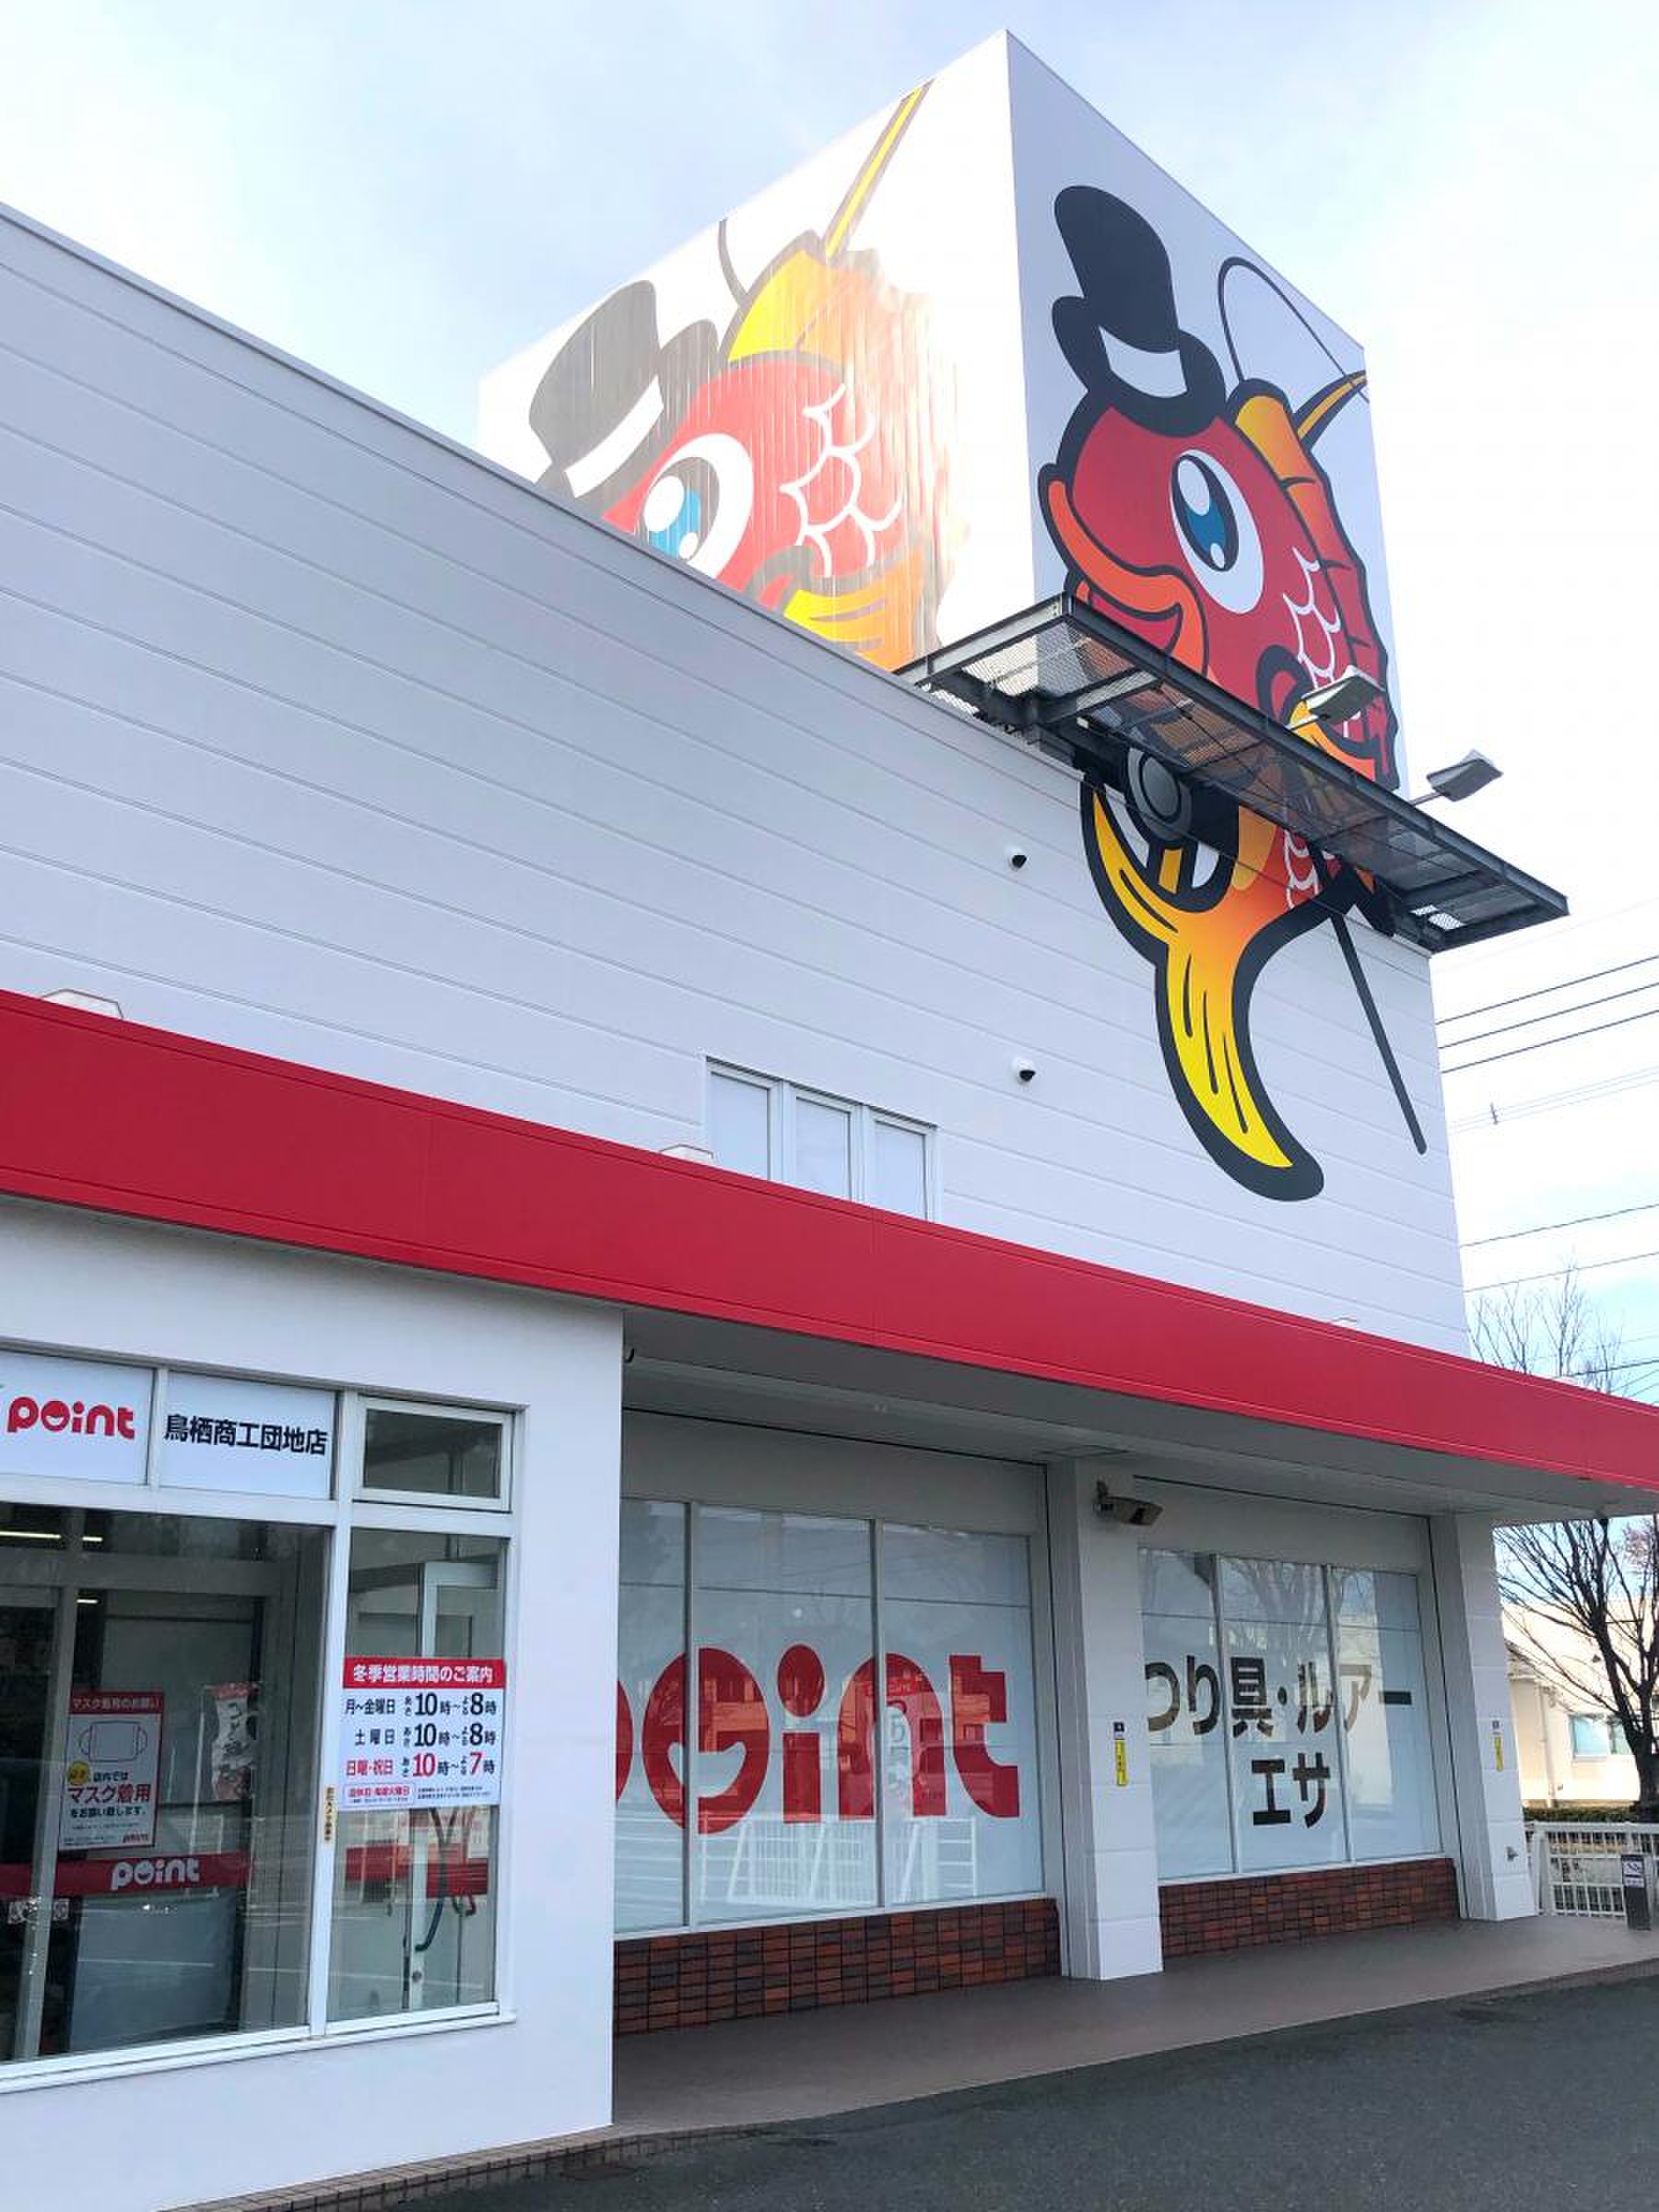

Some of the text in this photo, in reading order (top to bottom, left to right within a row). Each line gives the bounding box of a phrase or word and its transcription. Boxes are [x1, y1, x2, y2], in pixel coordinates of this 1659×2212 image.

[6, 1396, 135, 1440] point
[164, 1414, 327, 1455] 鳥栖商工団地店
[67, 1784, 151, 1803] マスク着用
[1251, 1752, 1330, 1828] エサ
[111, 1858, 200, 1890] point
